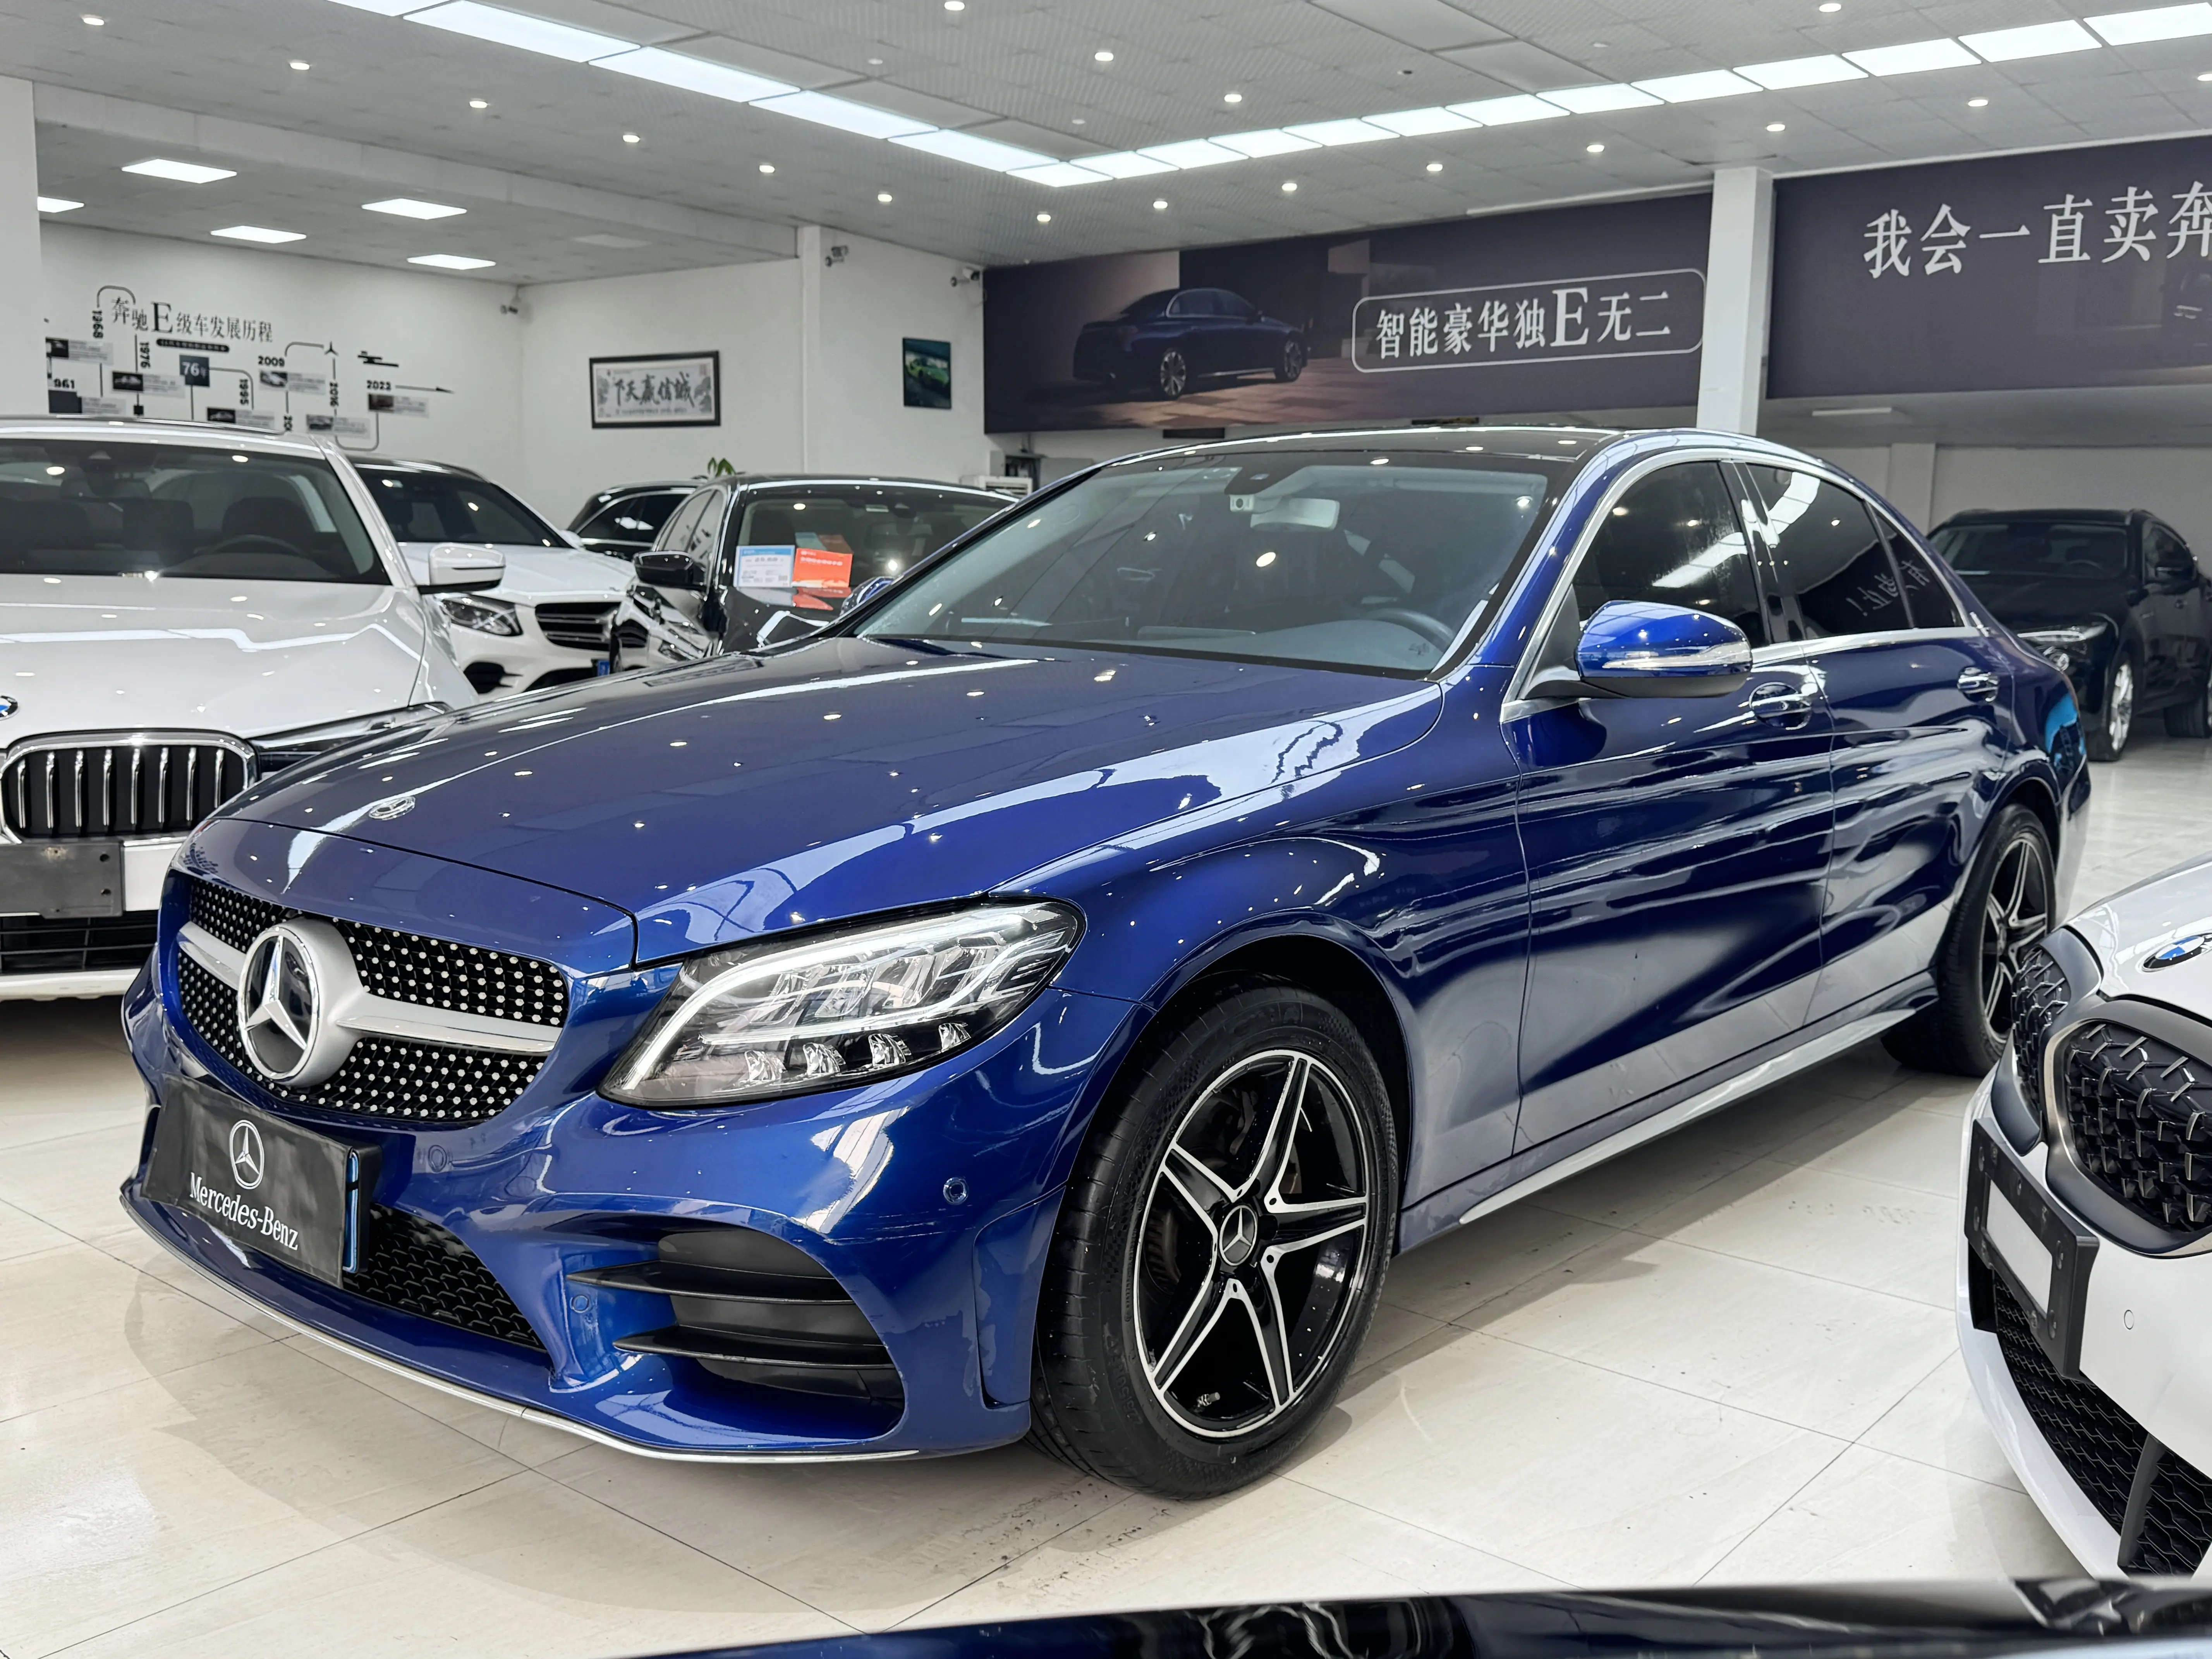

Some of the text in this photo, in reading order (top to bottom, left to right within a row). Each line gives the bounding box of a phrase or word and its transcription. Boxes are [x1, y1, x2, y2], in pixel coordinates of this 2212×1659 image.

[1863, 181, 2212, 279] 我会一直卖奔
[111, 296, 273, 343] 奔驰E级车发展历程
[139, 341, 151, 369] 1976
[1375, 287, 1671, 360] 智能豪华独E无二
[189, 1172, 299, 1251] Mercedes-Benz
